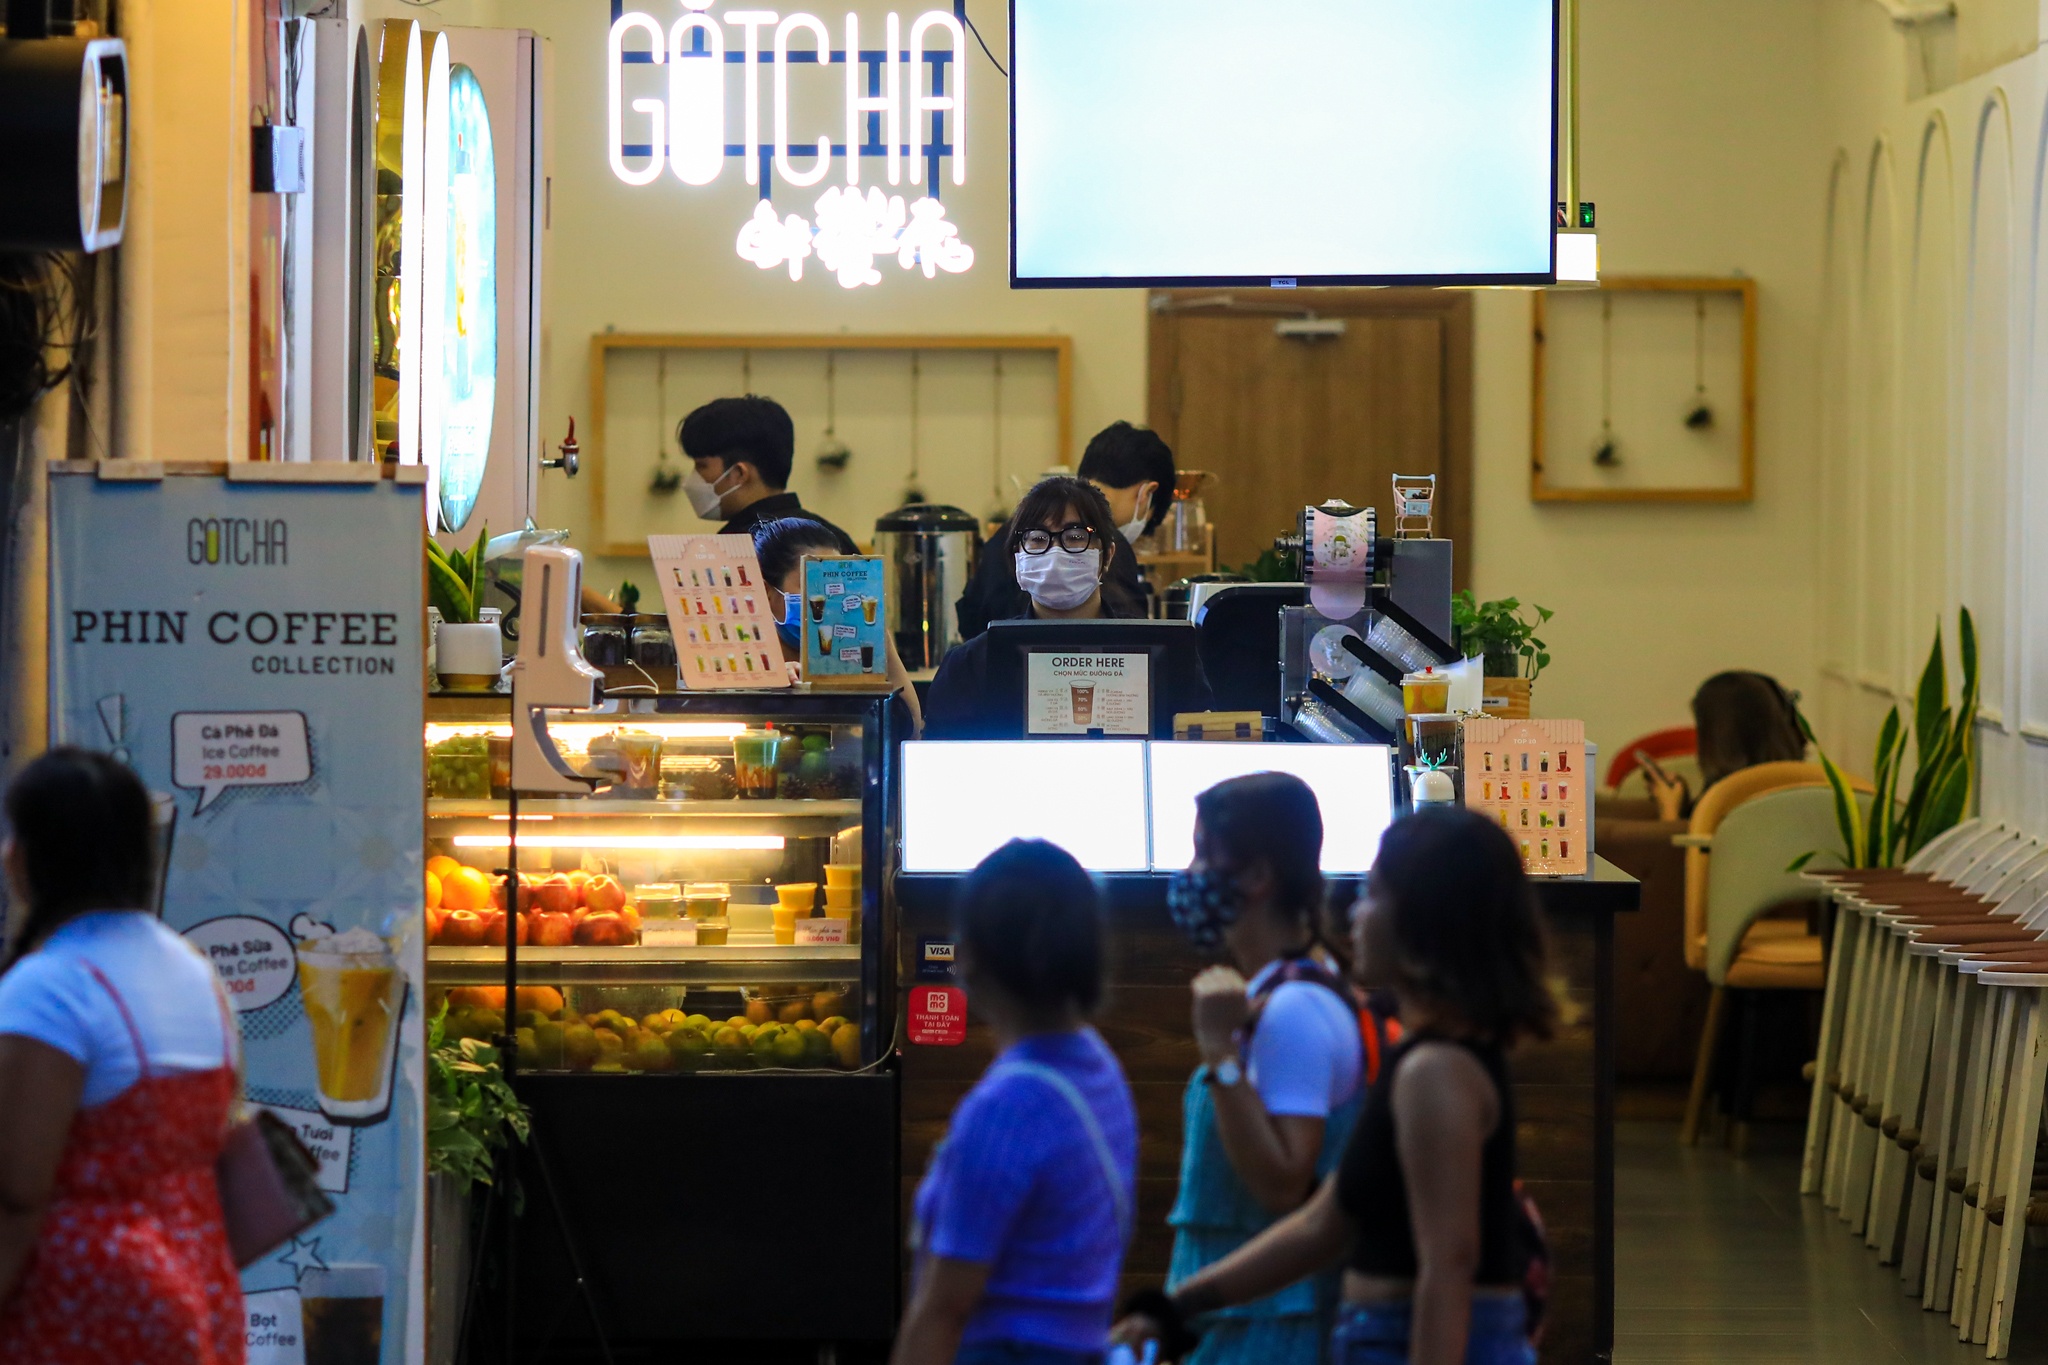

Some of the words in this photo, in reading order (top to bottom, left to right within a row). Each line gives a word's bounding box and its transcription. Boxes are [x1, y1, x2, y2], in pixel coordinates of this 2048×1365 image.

[608, 9, 966, 187] GOTCHA
[187, 517, 287, 566] GOTCHA
[72, 610, 188, 644] PHIN
[207, 611, 397, 645] COFFEE
[251, 655, 395, 675] COLLECTION
[1052, 657, 1093, 668] ORDER
[1096, 657, 1125, 668] HERE
[202, 746, 225, 759] Ice
[228, 744, 279, 759] Coffee
[930, 947, 951, 955] VISA
[237, 957, 288, 974] Coffee
[250, 1313, 277, 1331] Bọt
[246, 1331, 296, 1347] Coffee
